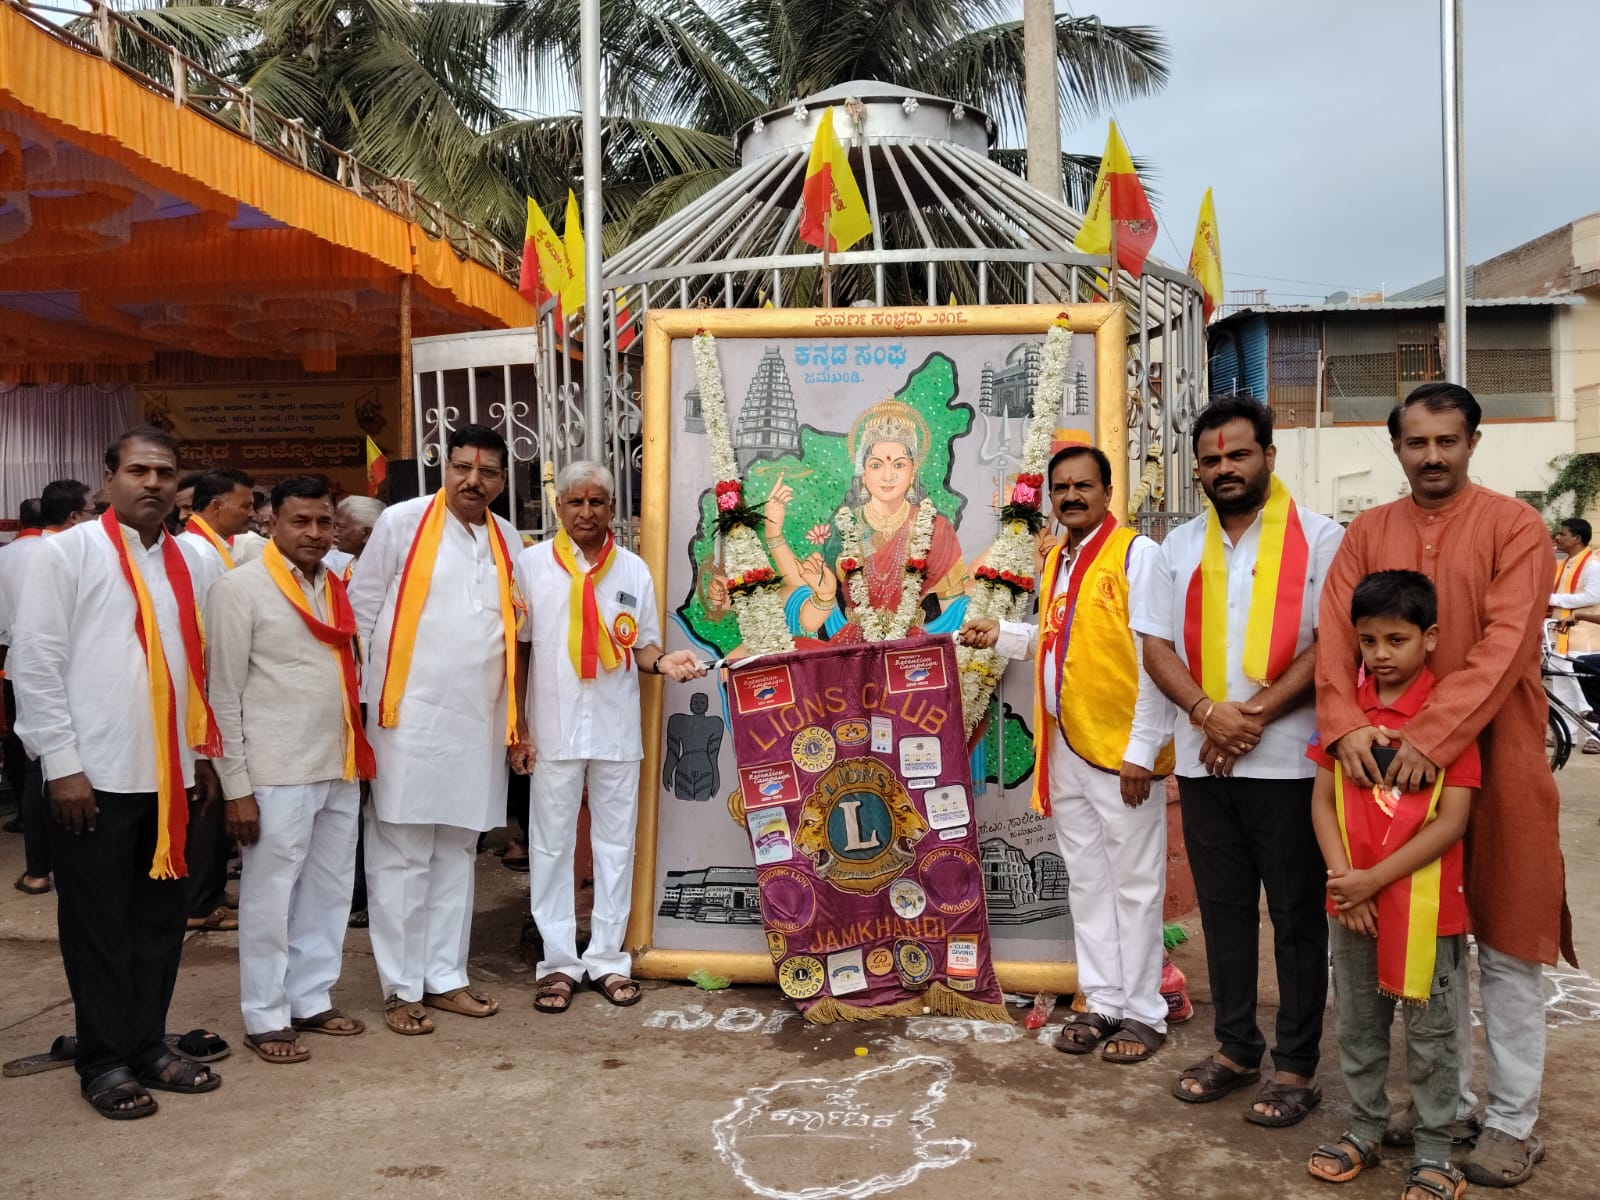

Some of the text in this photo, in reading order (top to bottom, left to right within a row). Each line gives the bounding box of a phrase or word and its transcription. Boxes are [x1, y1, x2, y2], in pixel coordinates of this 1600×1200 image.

[815, 311, 867, 327] ಸುವರ್ಣ
[871, 311, 923, 330] ಸಂಭ್ರಮ
[794, 342, 907, 371] ಕನ್ನಡ ಸಂಘ
[748, 682, 948, 751] LIONS CLUB
[793, 728, 832, 755] NEW CLUB
[798, 747, 835, 771] SPONSOR
[824, 767, 887, 797] LIONS
[839, 801, 881, 852] L
[922, 850, 973, 872] GUIDING LION
[760, 869, 809, 888] GUIDING LION
[940, 899, 970, 912] AWARD
[772, 919, 800, 931] AWARD
[809, 915, 946, 953] JAMKHANDI
[781, 956, 822, 976] NEW CLUB
[873, 950, 888, 964] 25
[782, 978, 823, 996] SPONSOR
